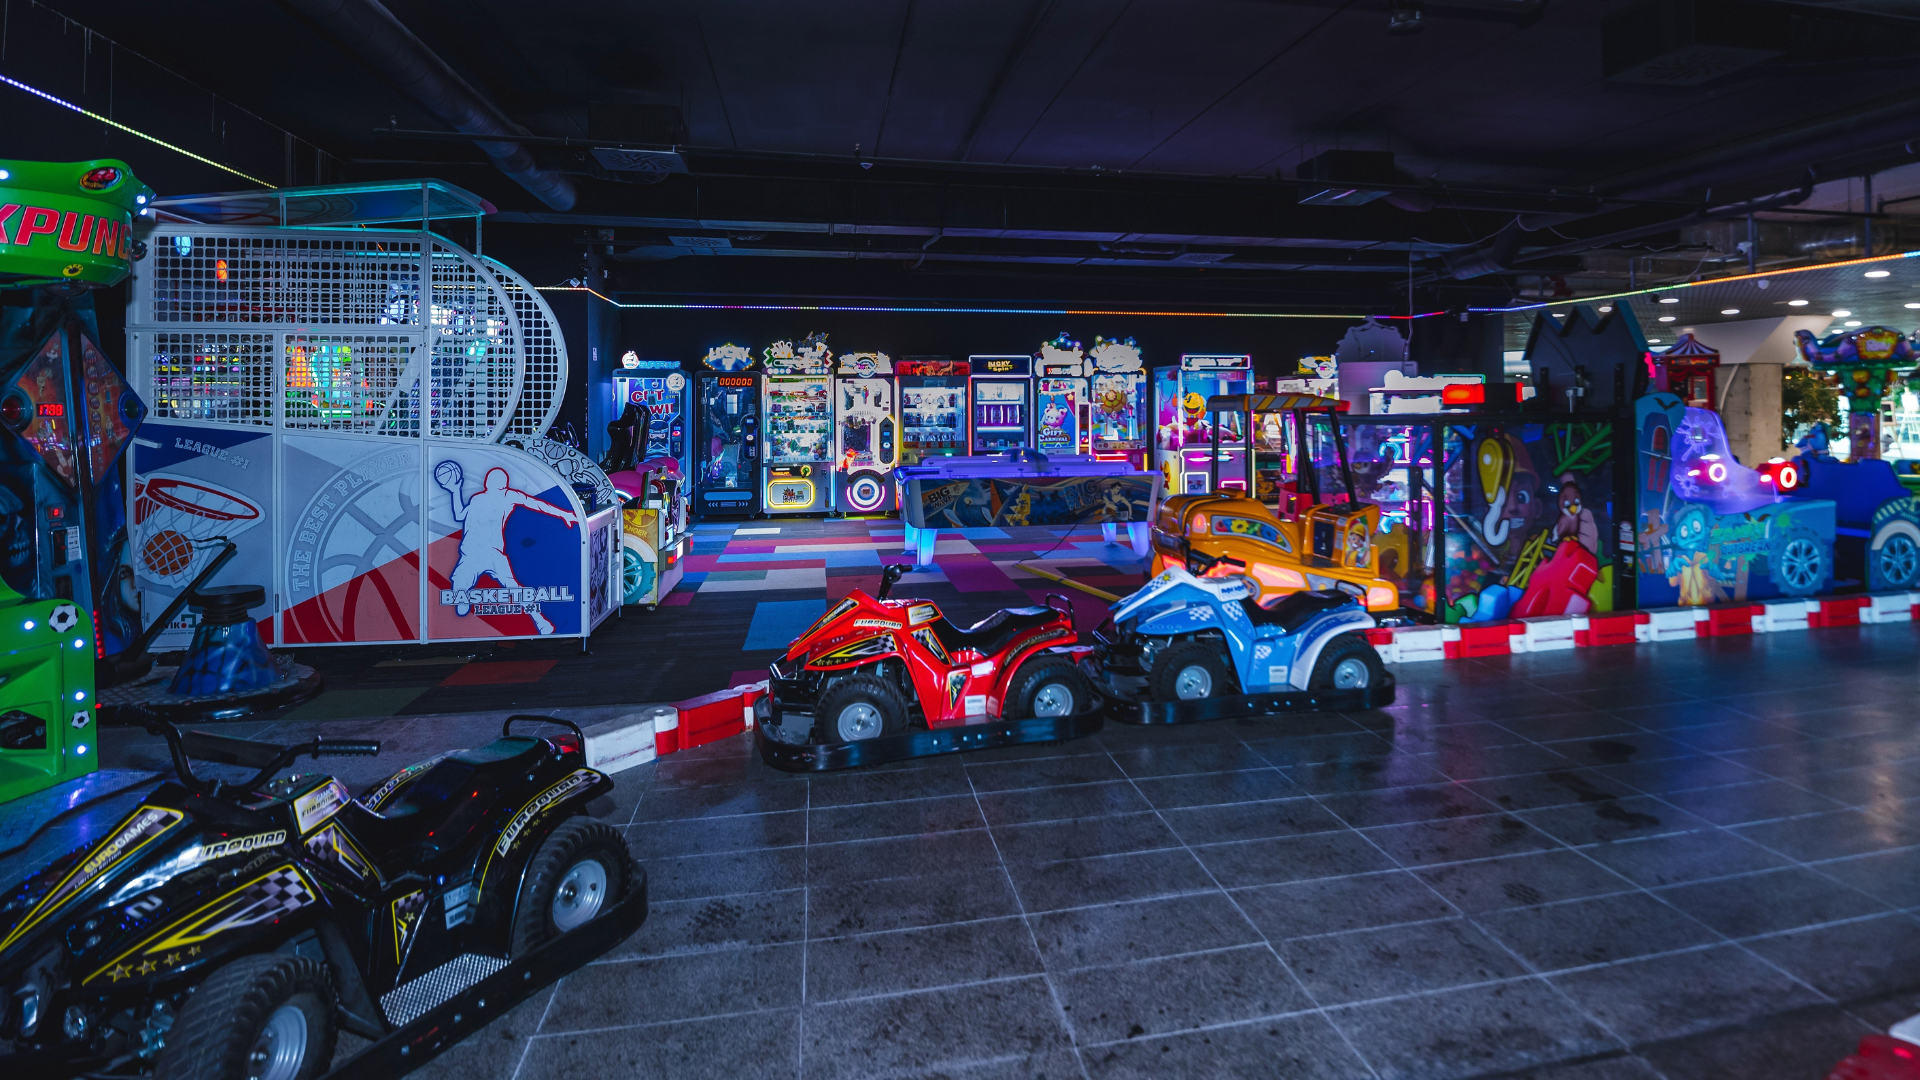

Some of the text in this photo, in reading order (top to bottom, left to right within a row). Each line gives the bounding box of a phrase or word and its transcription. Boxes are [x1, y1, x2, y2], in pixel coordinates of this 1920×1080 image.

[1043, 428, 1062, 436] GIFT
[175, 437, 249, 470] LEAGUE #1
[928, 487, 950, 503] BIG
[1063, 479, 1099, 501] BIG
[292, 450, 411, 591] THE BEST PLAYER
[624, 524, 648, 537] ANGER
[440, 586, 574, 605] BASKETBALL
[474, 603, 541, 615] LEAGUE #1
[497, 776, 582, 858] EUROQUAD
[84, 812, 158, 874] EUROGAMES
[177, 830, 287, 868] UROQUAD
